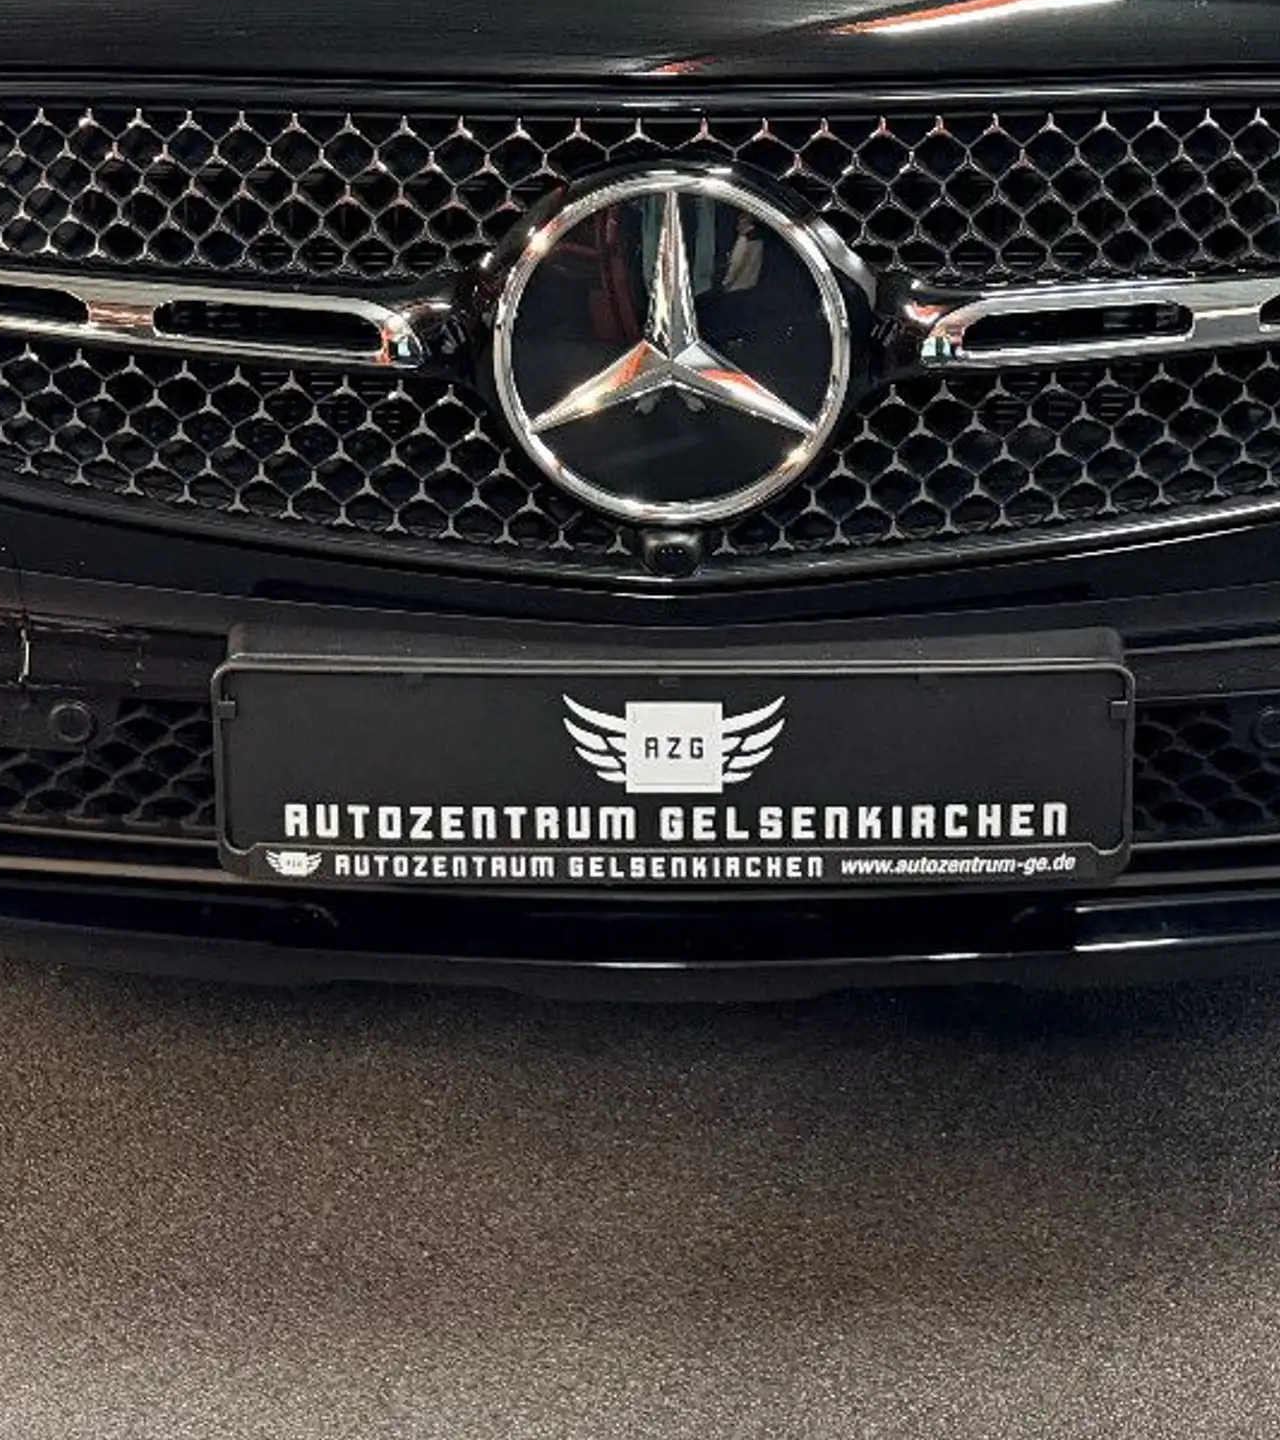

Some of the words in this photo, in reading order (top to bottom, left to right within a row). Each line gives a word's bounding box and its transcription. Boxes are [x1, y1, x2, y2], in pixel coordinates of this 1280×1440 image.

[643, 736, 705, 761] AZG
[283, 803, 637, 841] AUTOZENTRUM
[658, 802, 1070, 842] GELSENKIRCHEN
[334, 854, 556, 879] AUTOZENTRUM
[568, 854, 825, 879] GELSENKIRCHEN
[839, 854, 1077, 878] www.autozentrum-ge.de
